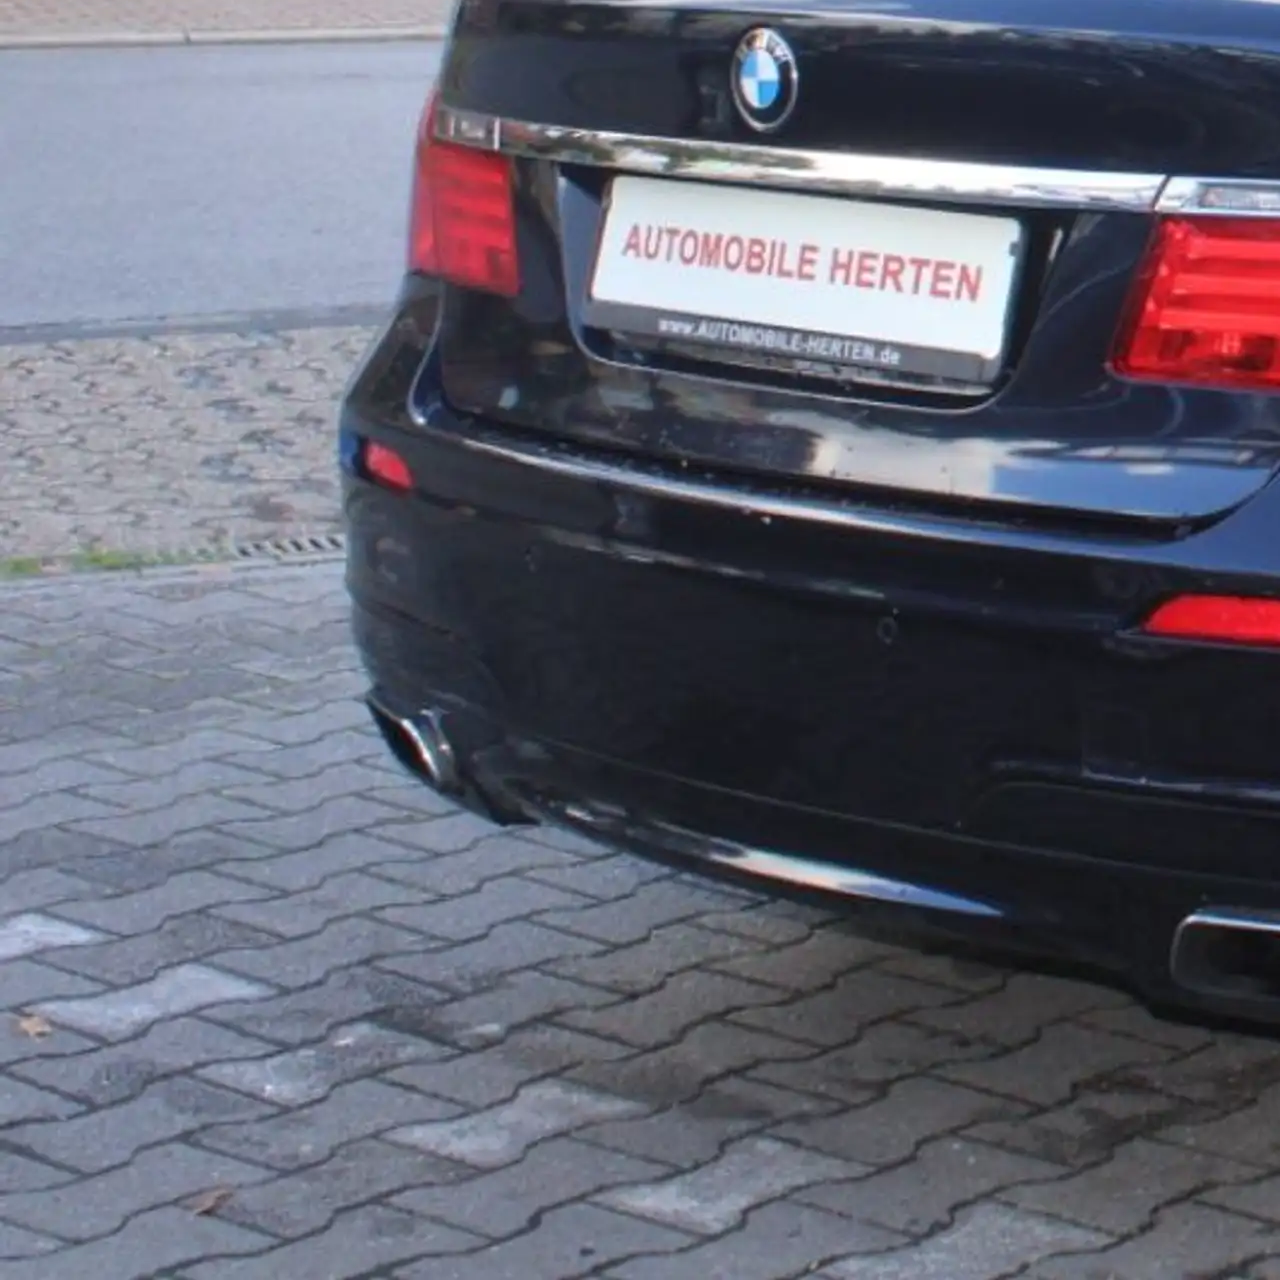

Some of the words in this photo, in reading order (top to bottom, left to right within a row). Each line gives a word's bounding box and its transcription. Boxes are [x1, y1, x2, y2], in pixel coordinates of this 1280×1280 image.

[621, 222, 820, 282] AUTOMOBILE
[829, 249, 984, 302] HERTEN
[657, 317, 902, 366] www.AUTOMOBILE-HERTEN.de
